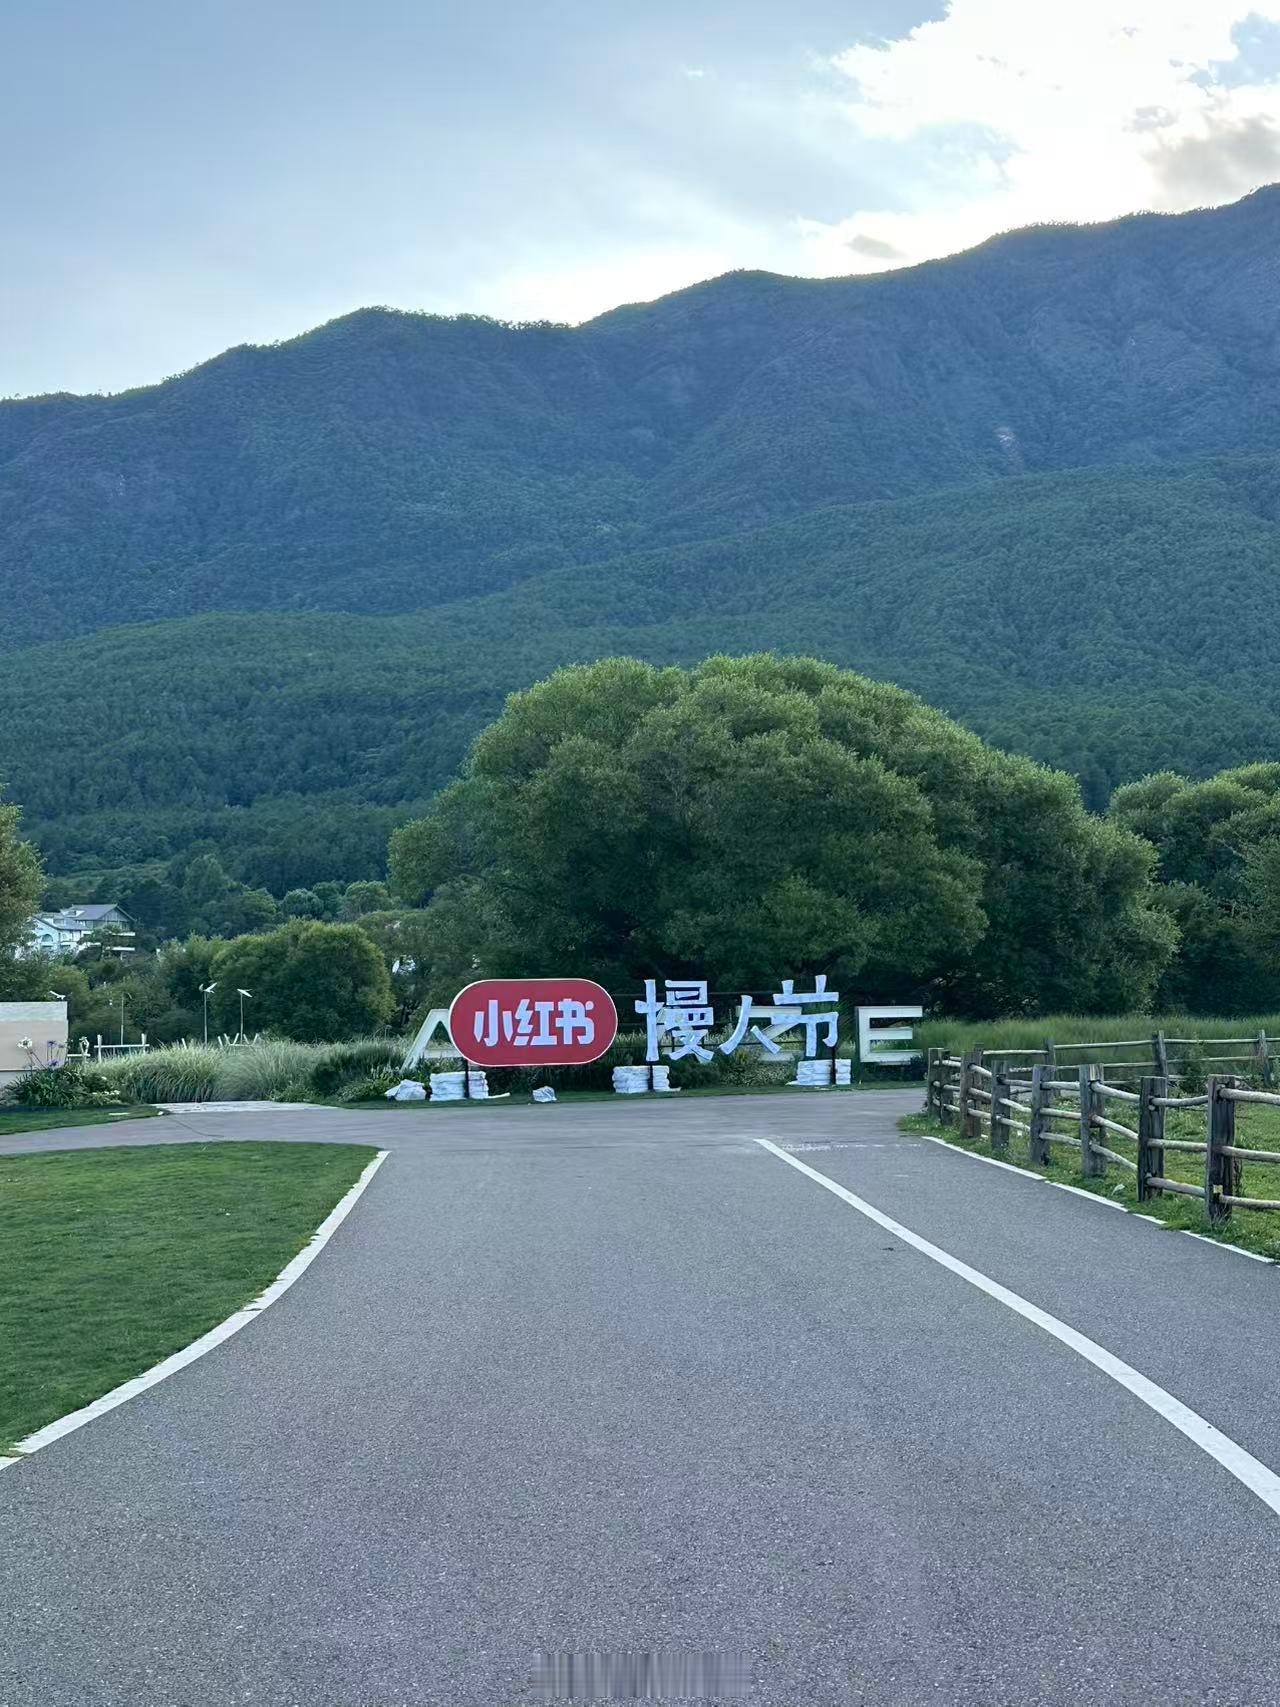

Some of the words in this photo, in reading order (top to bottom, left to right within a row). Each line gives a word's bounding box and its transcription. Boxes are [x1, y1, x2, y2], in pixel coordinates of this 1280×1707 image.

[473, 998, 595, 1047] 小红书
[634, 975, 839, 1062] 慢人节
